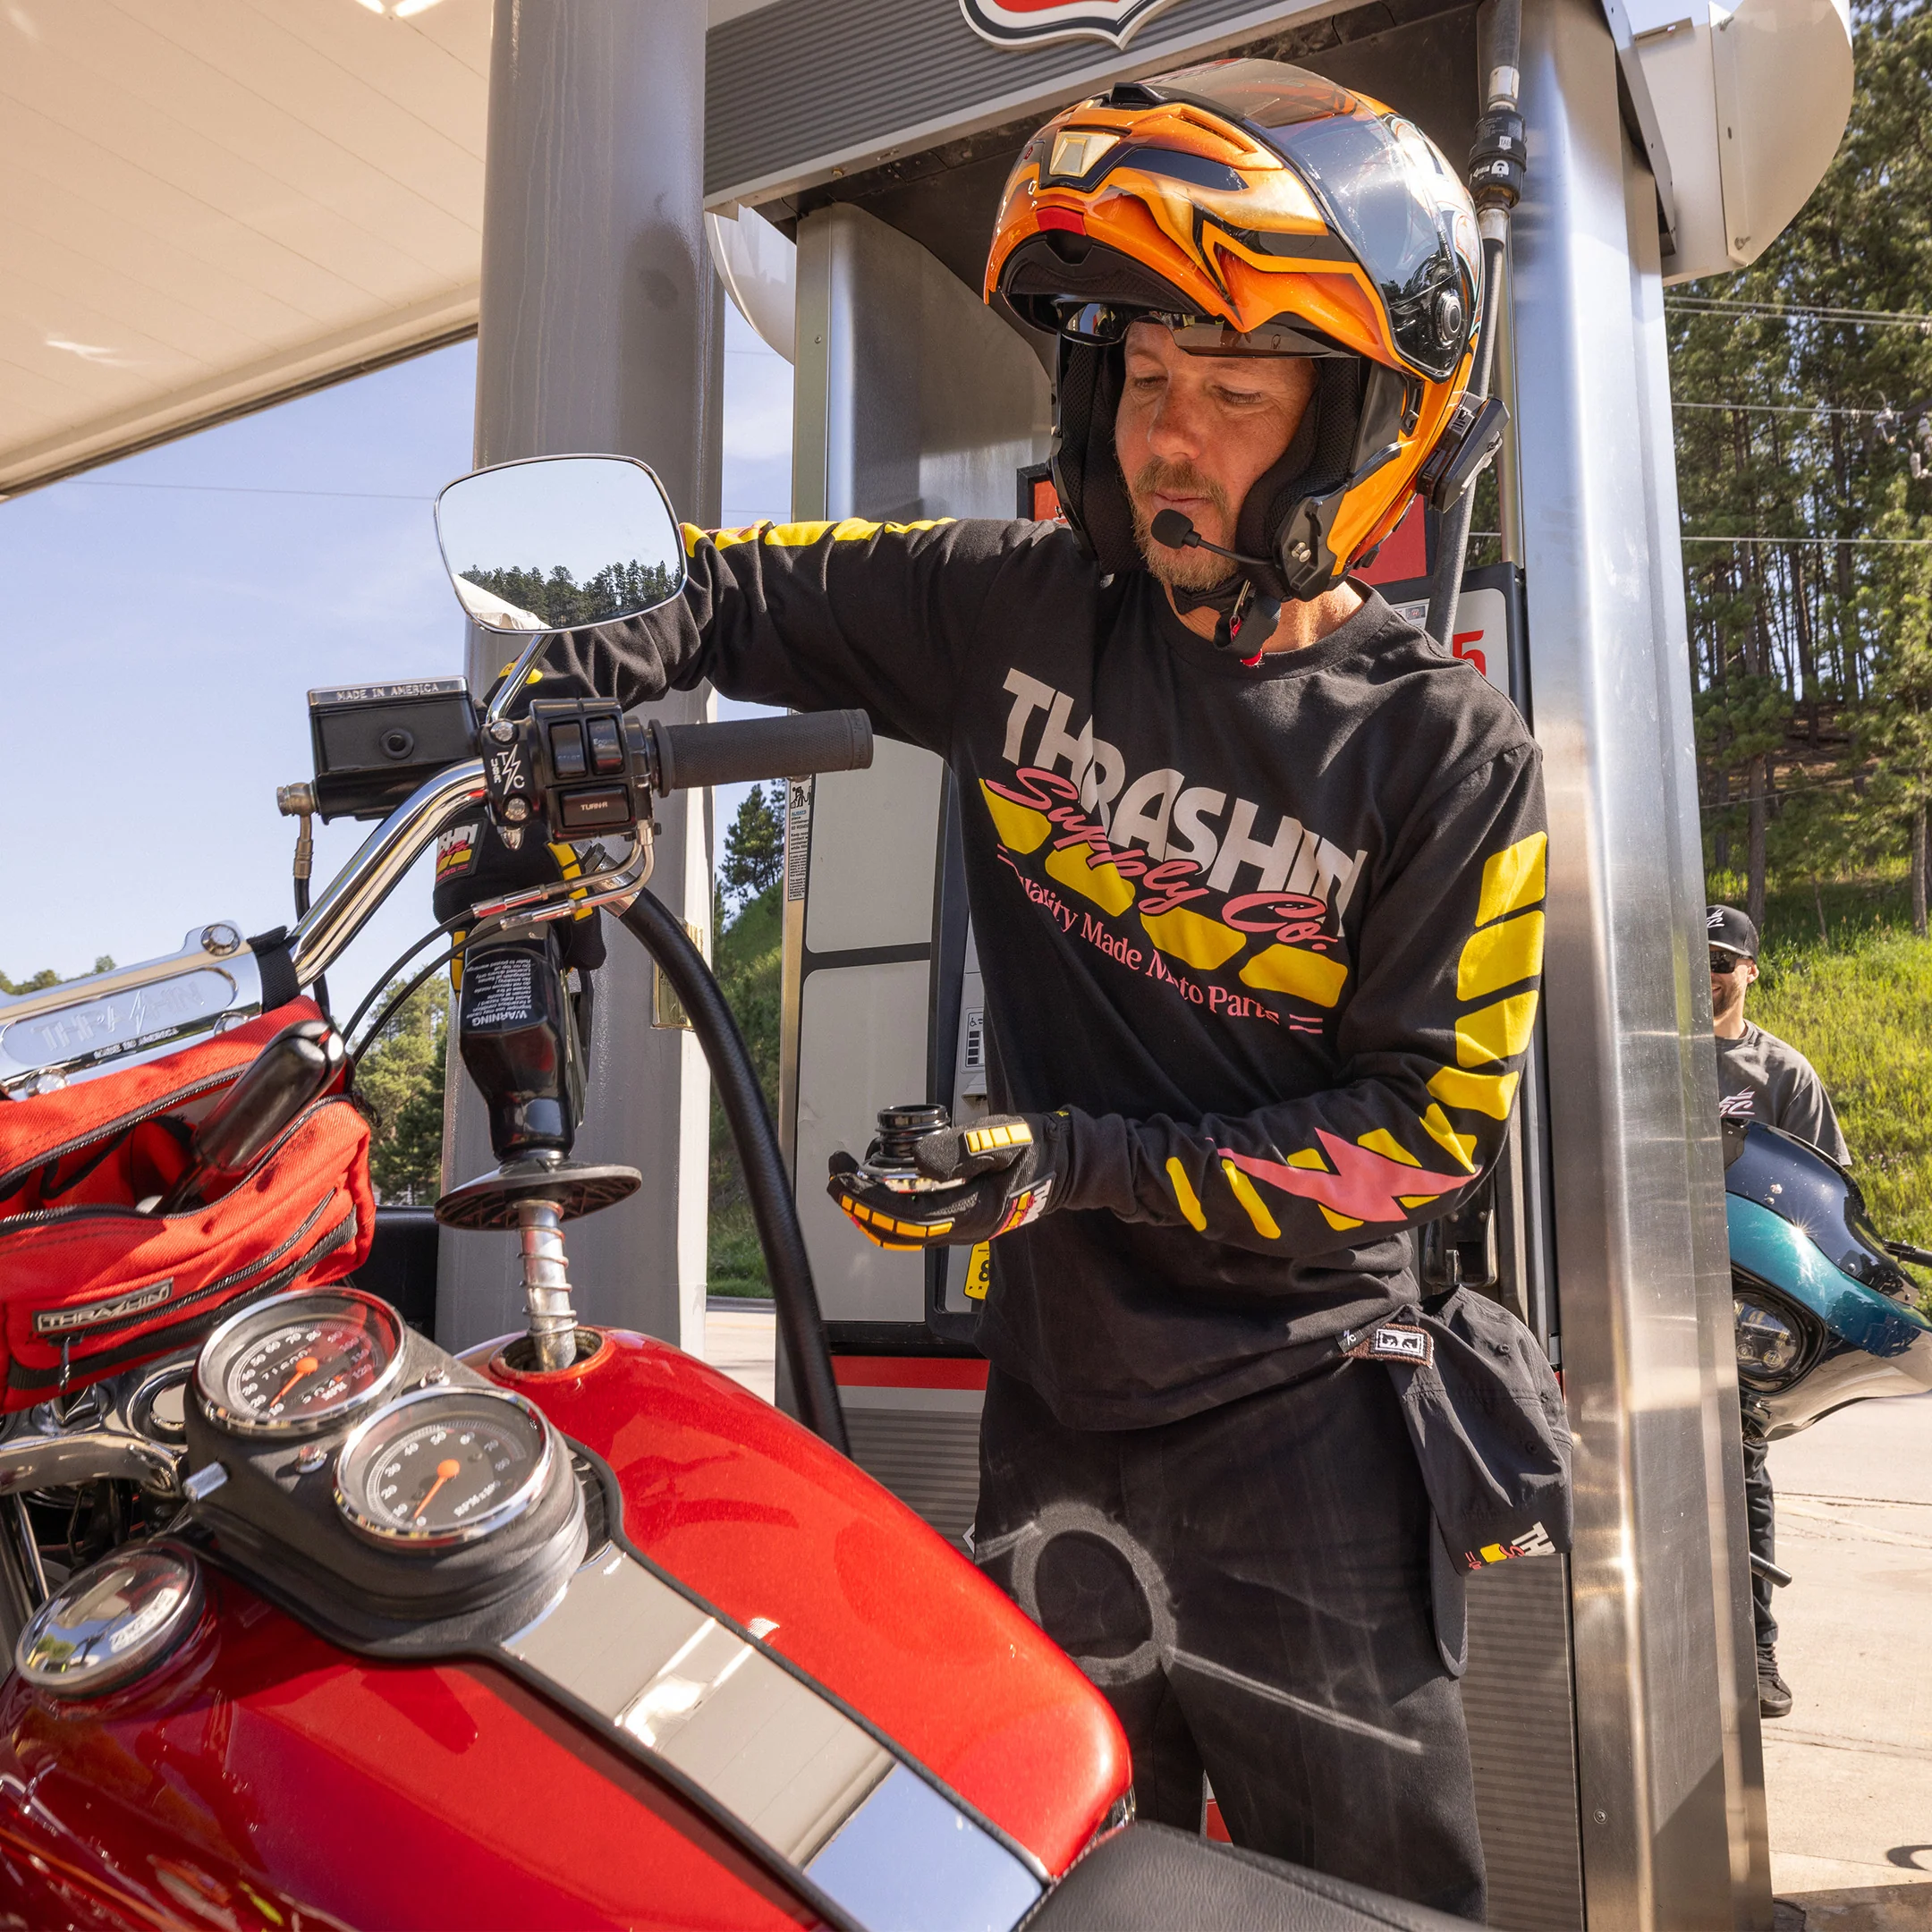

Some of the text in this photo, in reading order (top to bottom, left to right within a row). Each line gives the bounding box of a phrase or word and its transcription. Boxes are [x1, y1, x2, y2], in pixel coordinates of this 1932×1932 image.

[336, 682, 439, 701] MADE IN AMERICA
[985, 767, 1209, 914] Supply
[1002, 668, 1368, 936] THRASHIN
[1019, 877, 1078, 932] uality
[1080, 912, 1142, 970] Made
[471, 1010, 528, 1027] WARNING
